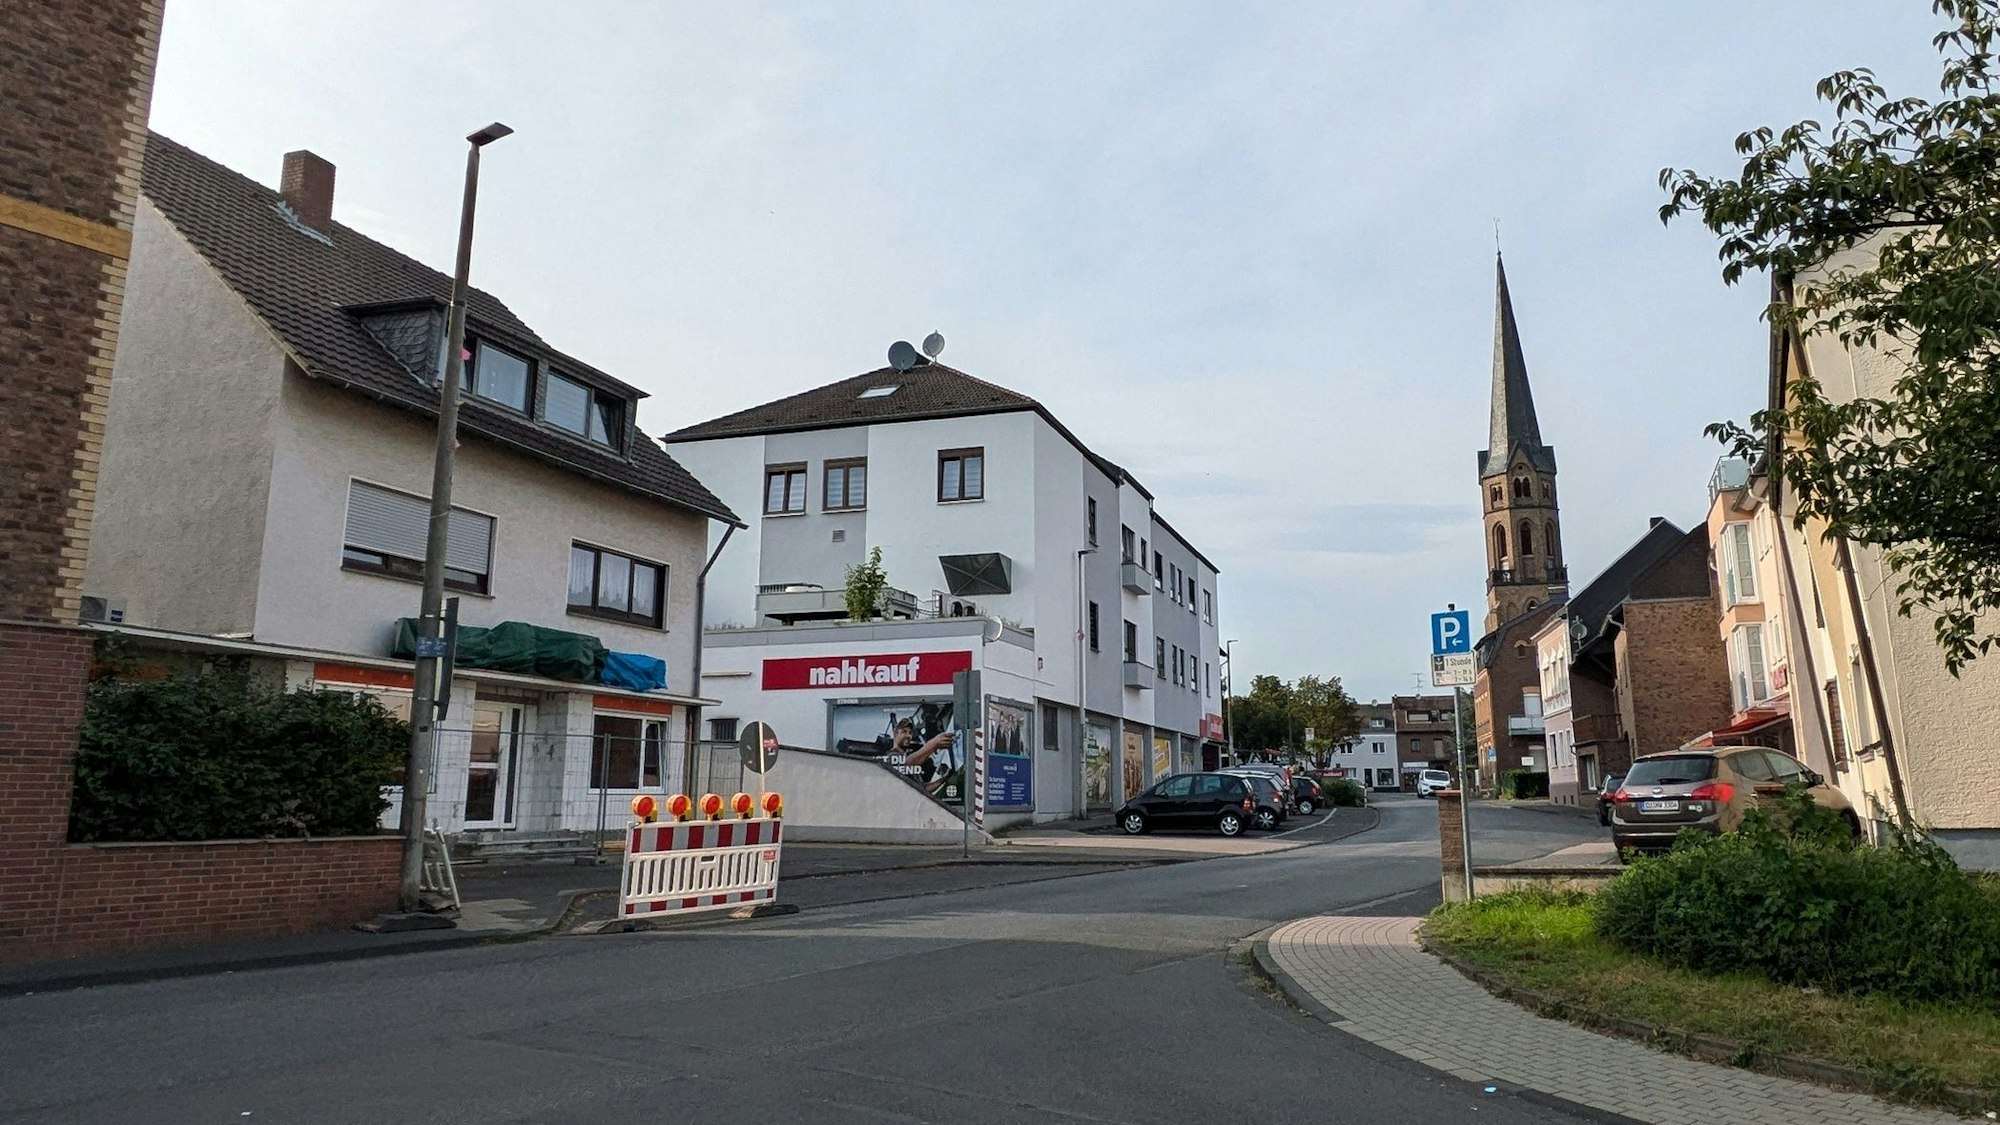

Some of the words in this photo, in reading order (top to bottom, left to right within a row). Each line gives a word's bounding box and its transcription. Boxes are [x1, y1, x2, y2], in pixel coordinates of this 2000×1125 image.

[1439, 616, 1461, 650] P
[809, 656, 921, 686] nahkauf
[1450, 657, 1472, 667] Stunde
[891, 755, 906, 764] DU
